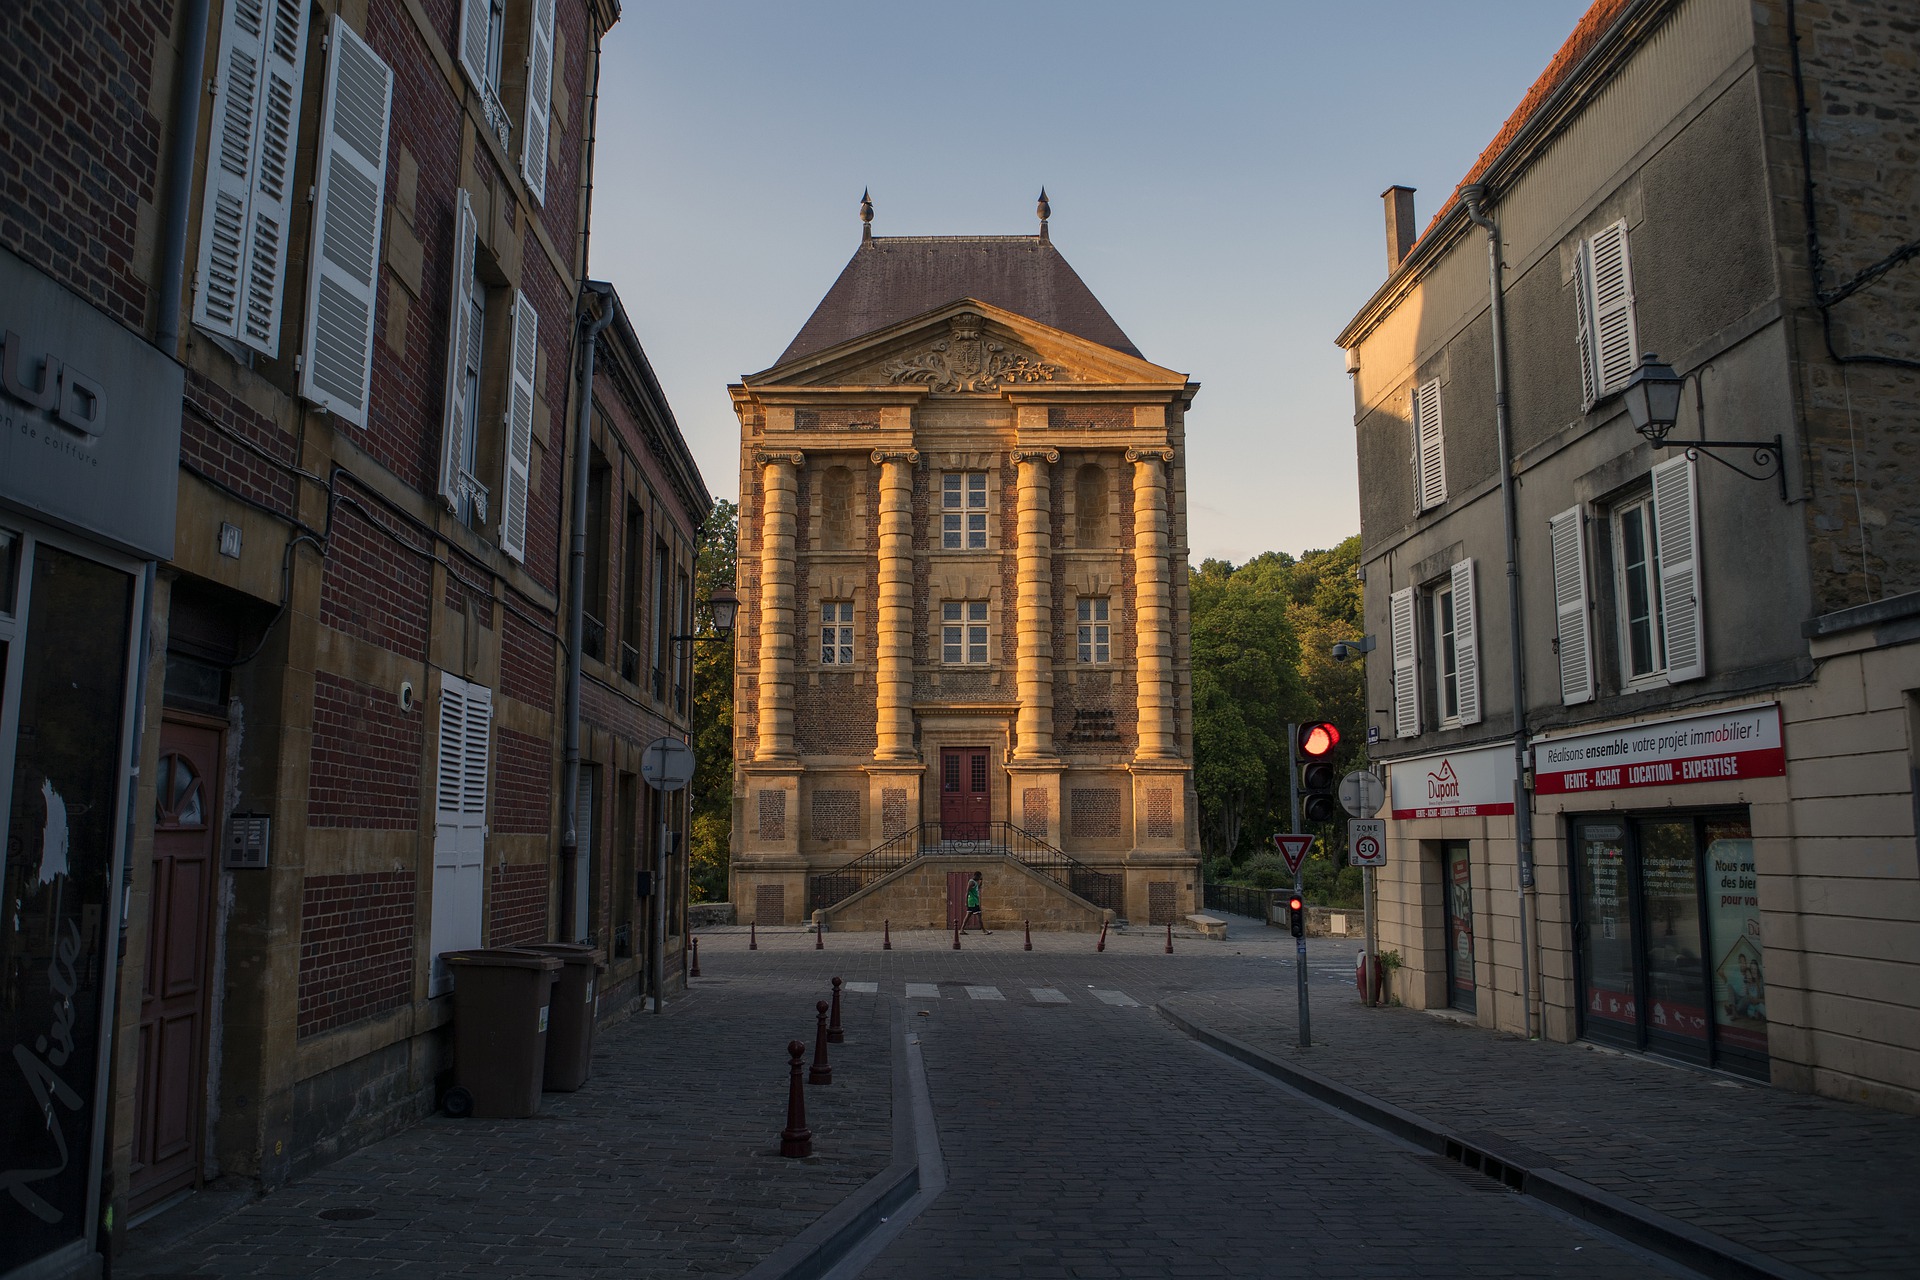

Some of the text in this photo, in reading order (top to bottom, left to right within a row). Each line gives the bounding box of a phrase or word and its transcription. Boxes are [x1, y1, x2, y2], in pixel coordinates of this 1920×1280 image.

[21, 422, 36, 439] de
[44, 435, 97, 467] coiffure
[226, 529, 238, 553] 61
[1548, 747, 1584, 763] Réalisons
[1586, 739, 1628, 758] ensemble
[1632, 737, 1656, 752] votre
[1658, 732, 1688, 754] projet
[1690, 723, 1752, 746] immobilier
[1564, 772, 1588, 790] VENTE
[1595, 768, 1620, 786] ACHAT
[1628, 763, 1673, 784] LOCATION
[1682, 756, 1738, 780] EXPERTISE
[1428, 780, 1460, 801] Dupont
[1356, 824, 1378, 832] ZONE
[1361, 843, 1374, 852] 30
[1643, 857, 1649, 865] Le
[1671, 858, 1692, 868] Dupont
[1715, 860, 1737, 872] Nous
[1721, 876, 1736, 888] des
[1721, 896, 1742, 907] pour
